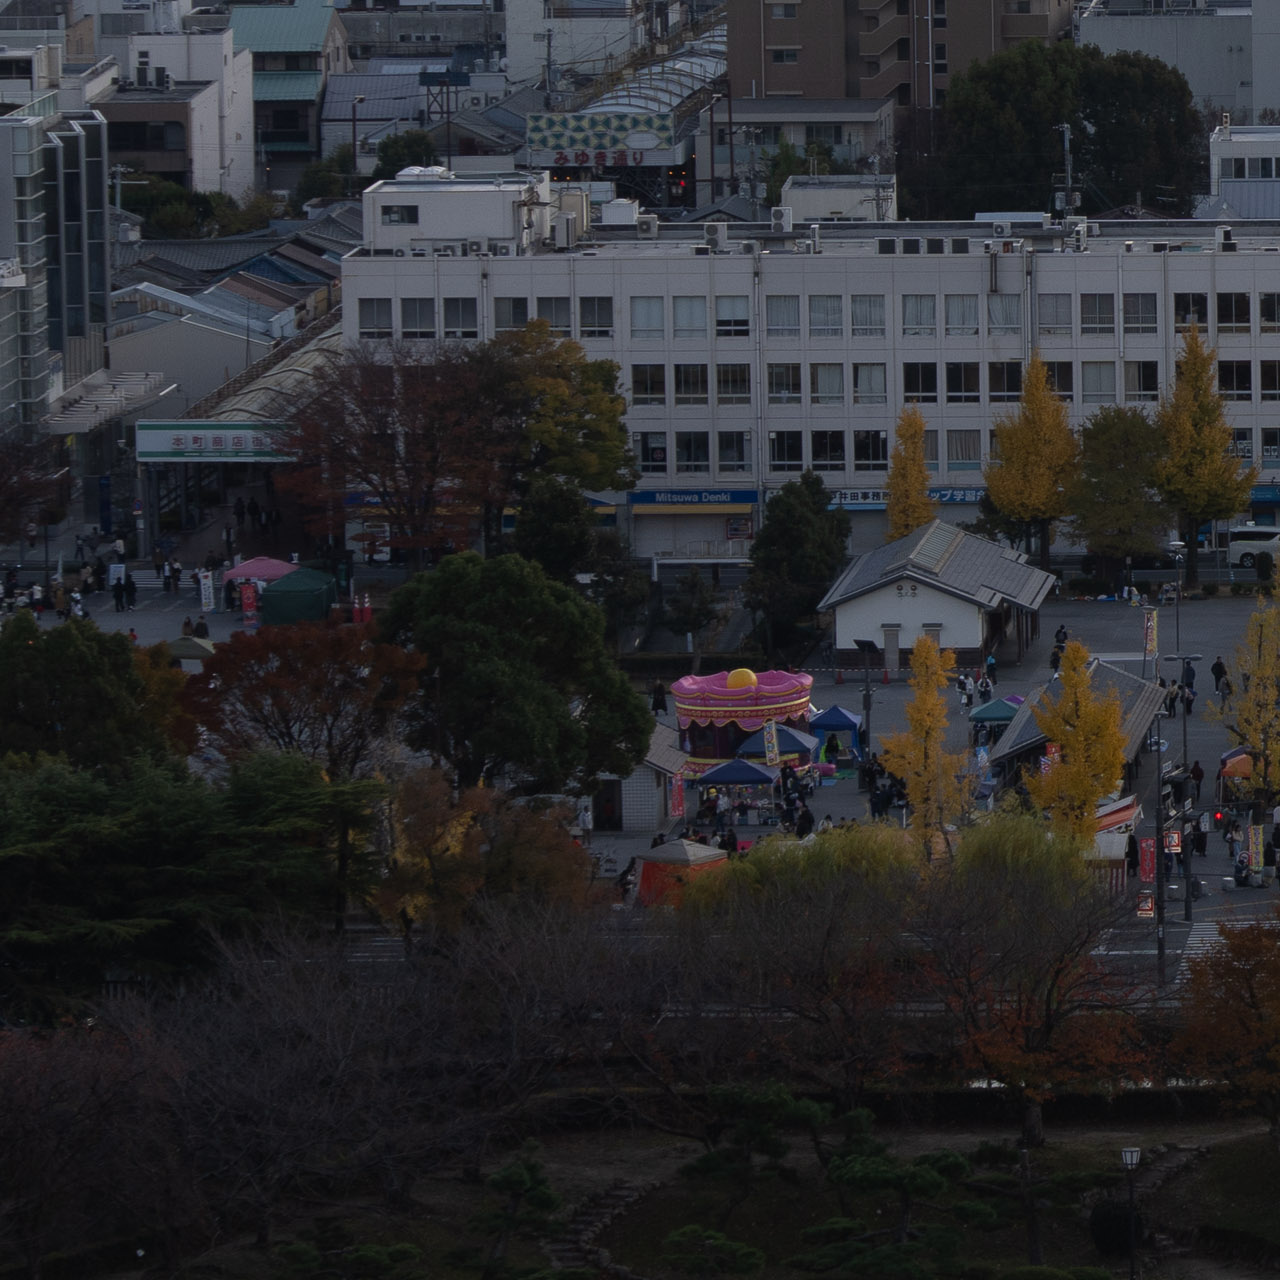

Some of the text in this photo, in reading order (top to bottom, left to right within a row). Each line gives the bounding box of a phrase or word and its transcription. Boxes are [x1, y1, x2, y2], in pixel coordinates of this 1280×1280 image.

[554, 151, 643, 166] みゆき通り
[655, 492, 731, 503] Mitsuwa Denki
